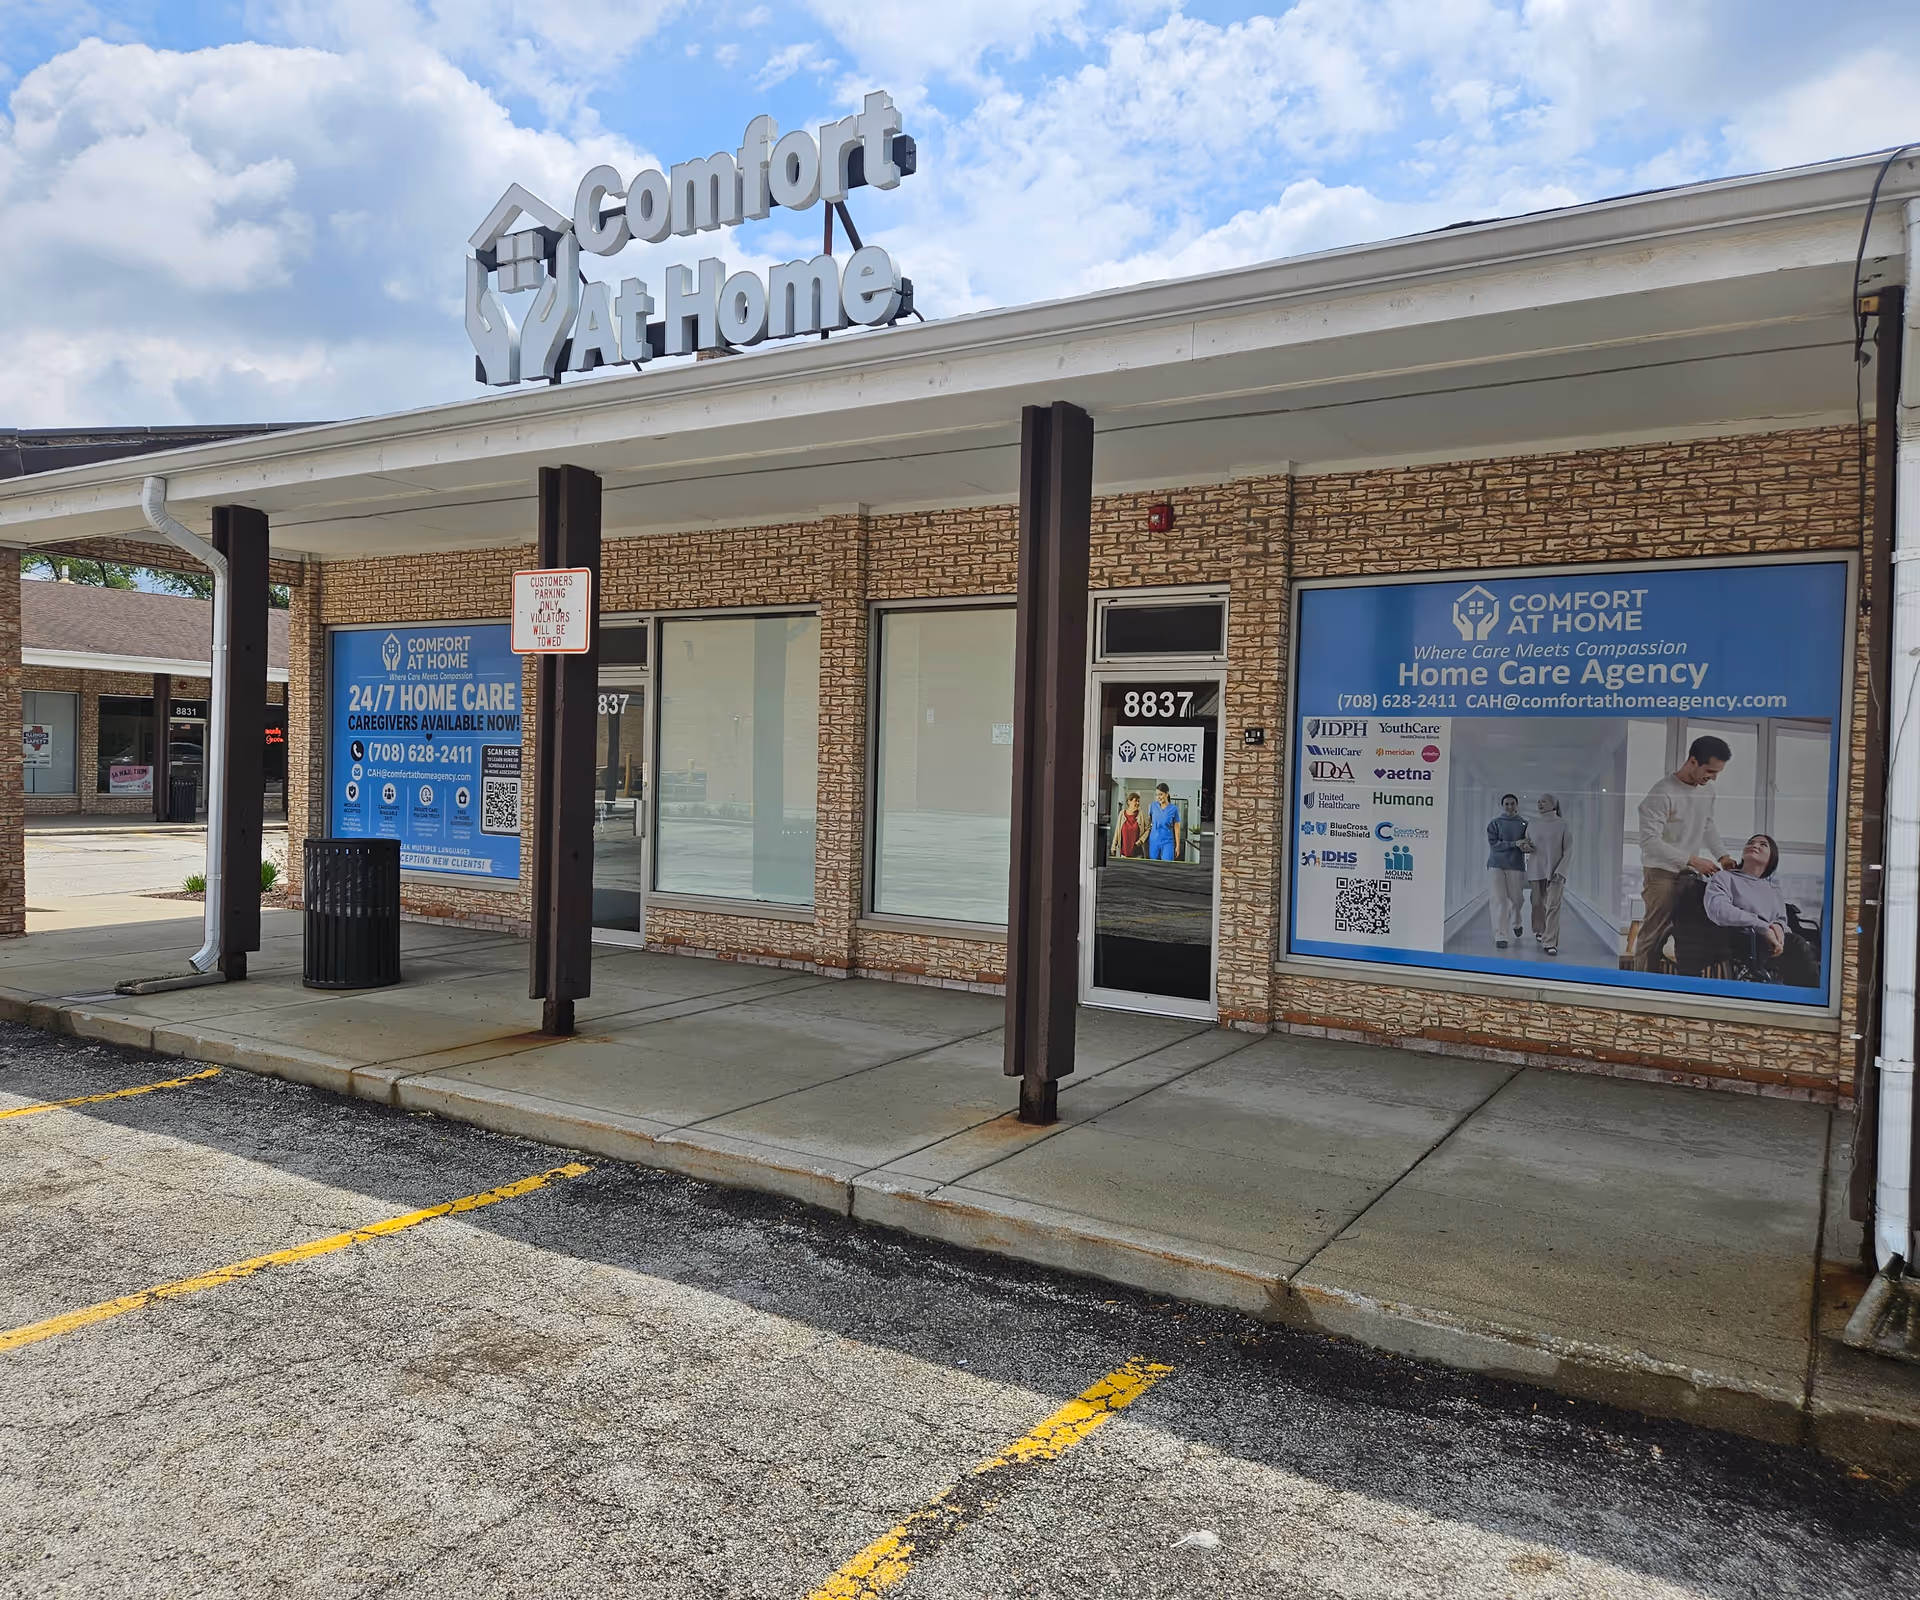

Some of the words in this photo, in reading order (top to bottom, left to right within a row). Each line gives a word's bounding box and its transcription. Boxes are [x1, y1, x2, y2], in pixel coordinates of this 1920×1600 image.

[574, 90, 902, 255] Comfort
[568, 277, 654, 371] At
[665, 246, 902, 355] Home
[530, 576, 573, 587] CUSTOMERS
[534, 588, 566, 599] PARKING
[540, 600, 559, 611] ONLY
[1509, 589, 1648, 612] COMFORT
[530, 612, 570, 623] VIOLATORS
[1507, 615, 1544, 635] AT
[1552, 611, 1643, 633] HOME
[533, 625, 549, 635] WILL
[556, 625, 565, 635] BE
[407, 636, 471, 653] COMFORT
[537, 637, 561, 647] TOWED
[1414, 646, 1466, 660] Where
[1472, 645, 1510, 659] Care
[1515, 643, 1569, 658] Meets
[1575, 640, 1687, 658] Compassion
[407, 654, 424, 670] AT
[427, 653, 468, 669] HOME
[389, 672, 406, 680] Where
[408, 672, 420, 680] Care
[422, 672, 438, 680] Meets
[440, 671, 472, 681] Compassion
[1399, 662, 1488, 687] Home
[1499, 661, 1571, 685] Care
[1580, 658, 1708, 690] Agency
[349, 684, 395, 712] 24/7
[400, 684, 457, 711] HOME
[462, 683, 515, 711] CARE
[1337, 692, 1378, 711] (708)
[1382, 693, 1457, 709] 628-2411
[1465, 692, 1787, 711] CAH@comfortathomeagency.com
[597, 694, 630, 715] 837
[1124, 691, 1194, 718] 8837
[175, 707, 196, 716] 8831
[348, 714, 418, 731] CAREGIVERS
[421, 714, 484, 731] AVAILABLE
[487, 714, 520, 731] NOW!
[1379, 722, 1440, 734] YouthCare
[1321, 722, 1368, 736] IDPH
[368, 742, 405, 763] (708)
[408, 744, 472, 764] 628-2411
[487, 748, 503, 756] SCAN
[503, 748, 519, 756] HERE
[1140, 742, 1198, 753] COMFORT
[1322, 747, 1361, 756] WellCare
[1139, 752, 1155, 763] AT
[1158, 752, 1195, 763] HOME
[367, 768, 471, 782] CAH@comfortathomeagency.com
[1387, 768, 1432, 780] aetna
[1318, 793, 1344, 801] United
[1373, 792, 1433, 807] Humana
[1318, 801, 1360, 810] Healthcare
[1330, 822, 1368, 831] BlueCross
[1330, 830, 1371, 839] BlueShield
[411, 844, 437, 853] MULTIPLE
[438, 847, 470, 855] LANGUAGES
[400, 853, 430, 865] CEPTING
[433, 856, 450, 866] NEW
[451, 858, 485, 869] CLIENTS!
[1322, 850, 1358, 863] IDHS
